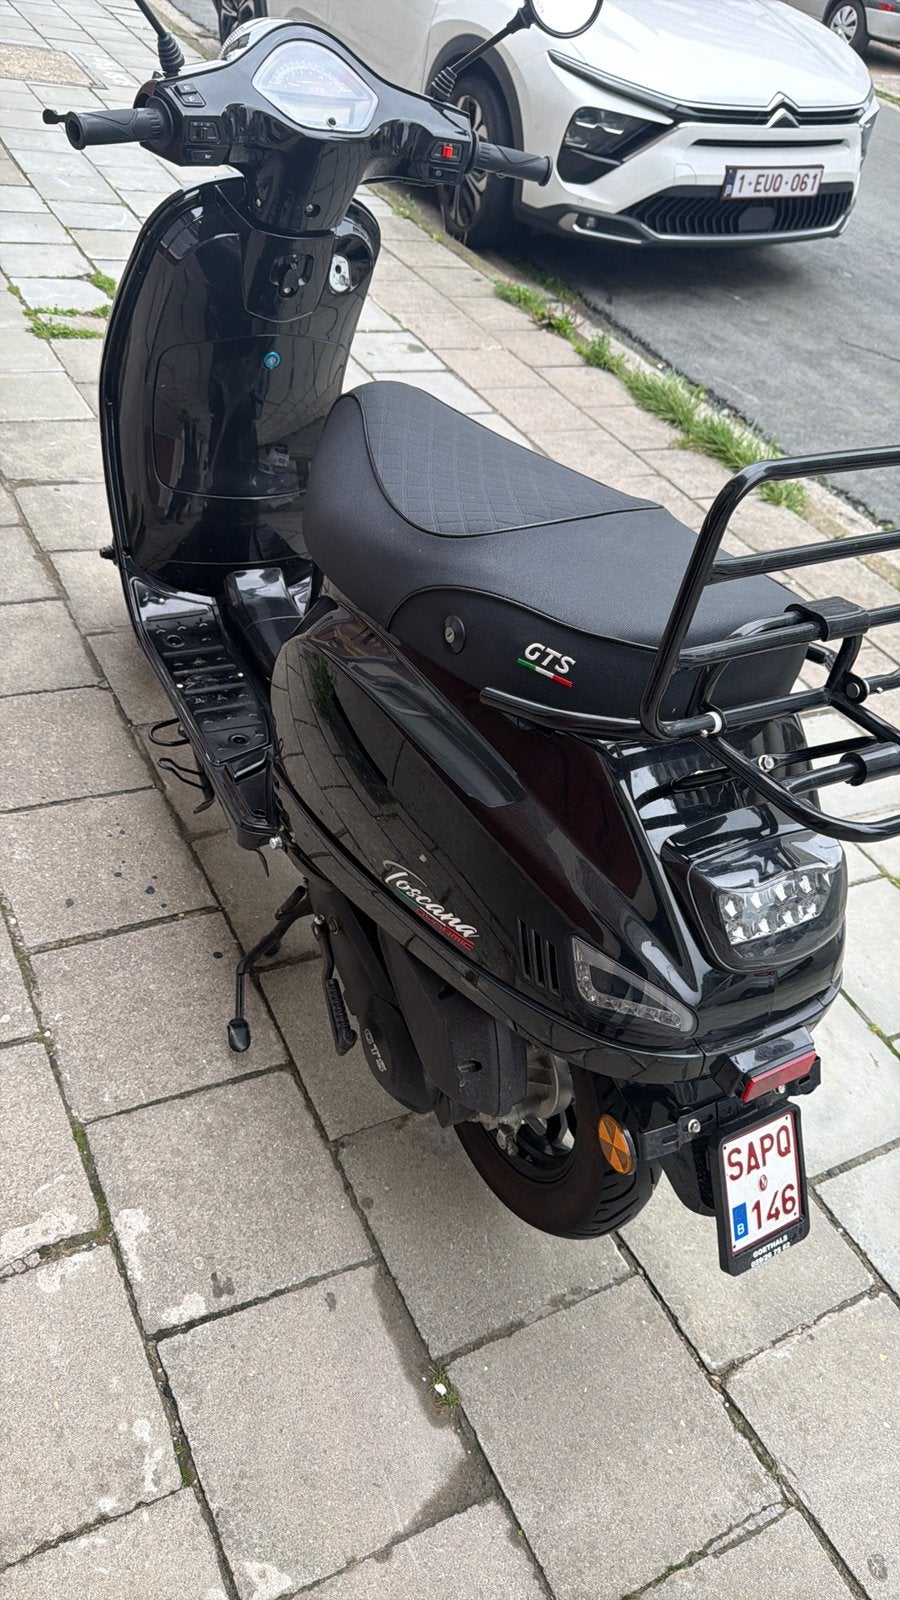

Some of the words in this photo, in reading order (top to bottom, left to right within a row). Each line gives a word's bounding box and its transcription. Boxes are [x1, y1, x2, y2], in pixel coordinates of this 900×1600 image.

[524, 642, 577, 674] GTS
[383, 860, 480, 938] Toscana
[364, 1028, 387, 1072] GTS
[727, 1125, 791, 1181] SAPQ
[737, 1222, 745, 1236] B
[751, 1183, 796, 1230] 146
